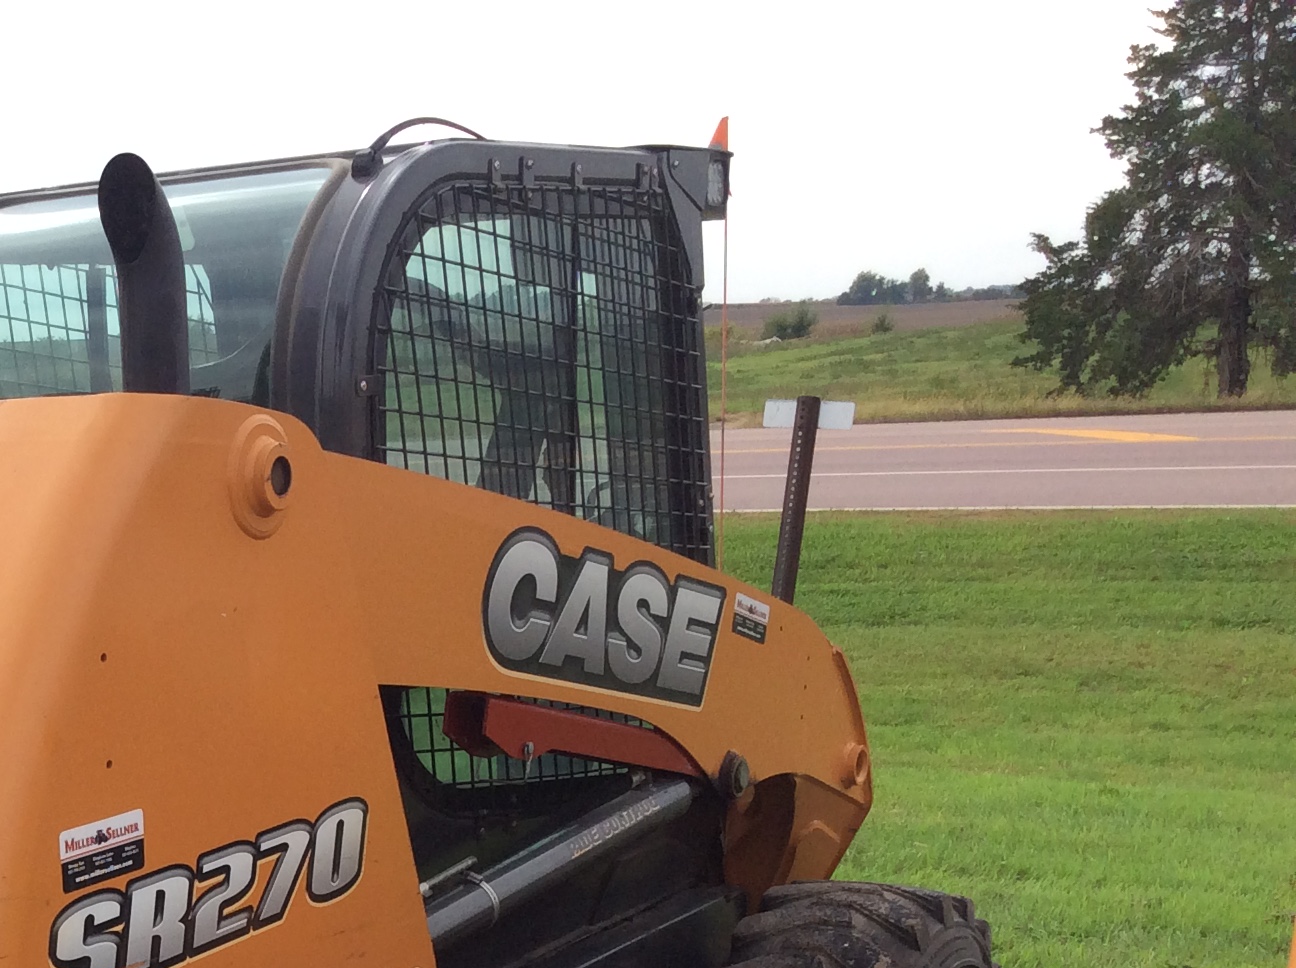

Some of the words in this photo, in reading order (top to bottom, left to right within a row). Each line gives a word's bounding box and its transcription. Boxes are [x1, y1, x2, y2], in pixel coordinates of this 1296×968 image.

[483, 528, 725, 697] CASE
[64, 836, 97, 854] MILLER
[105, 822, 140, 842] SELLNER
